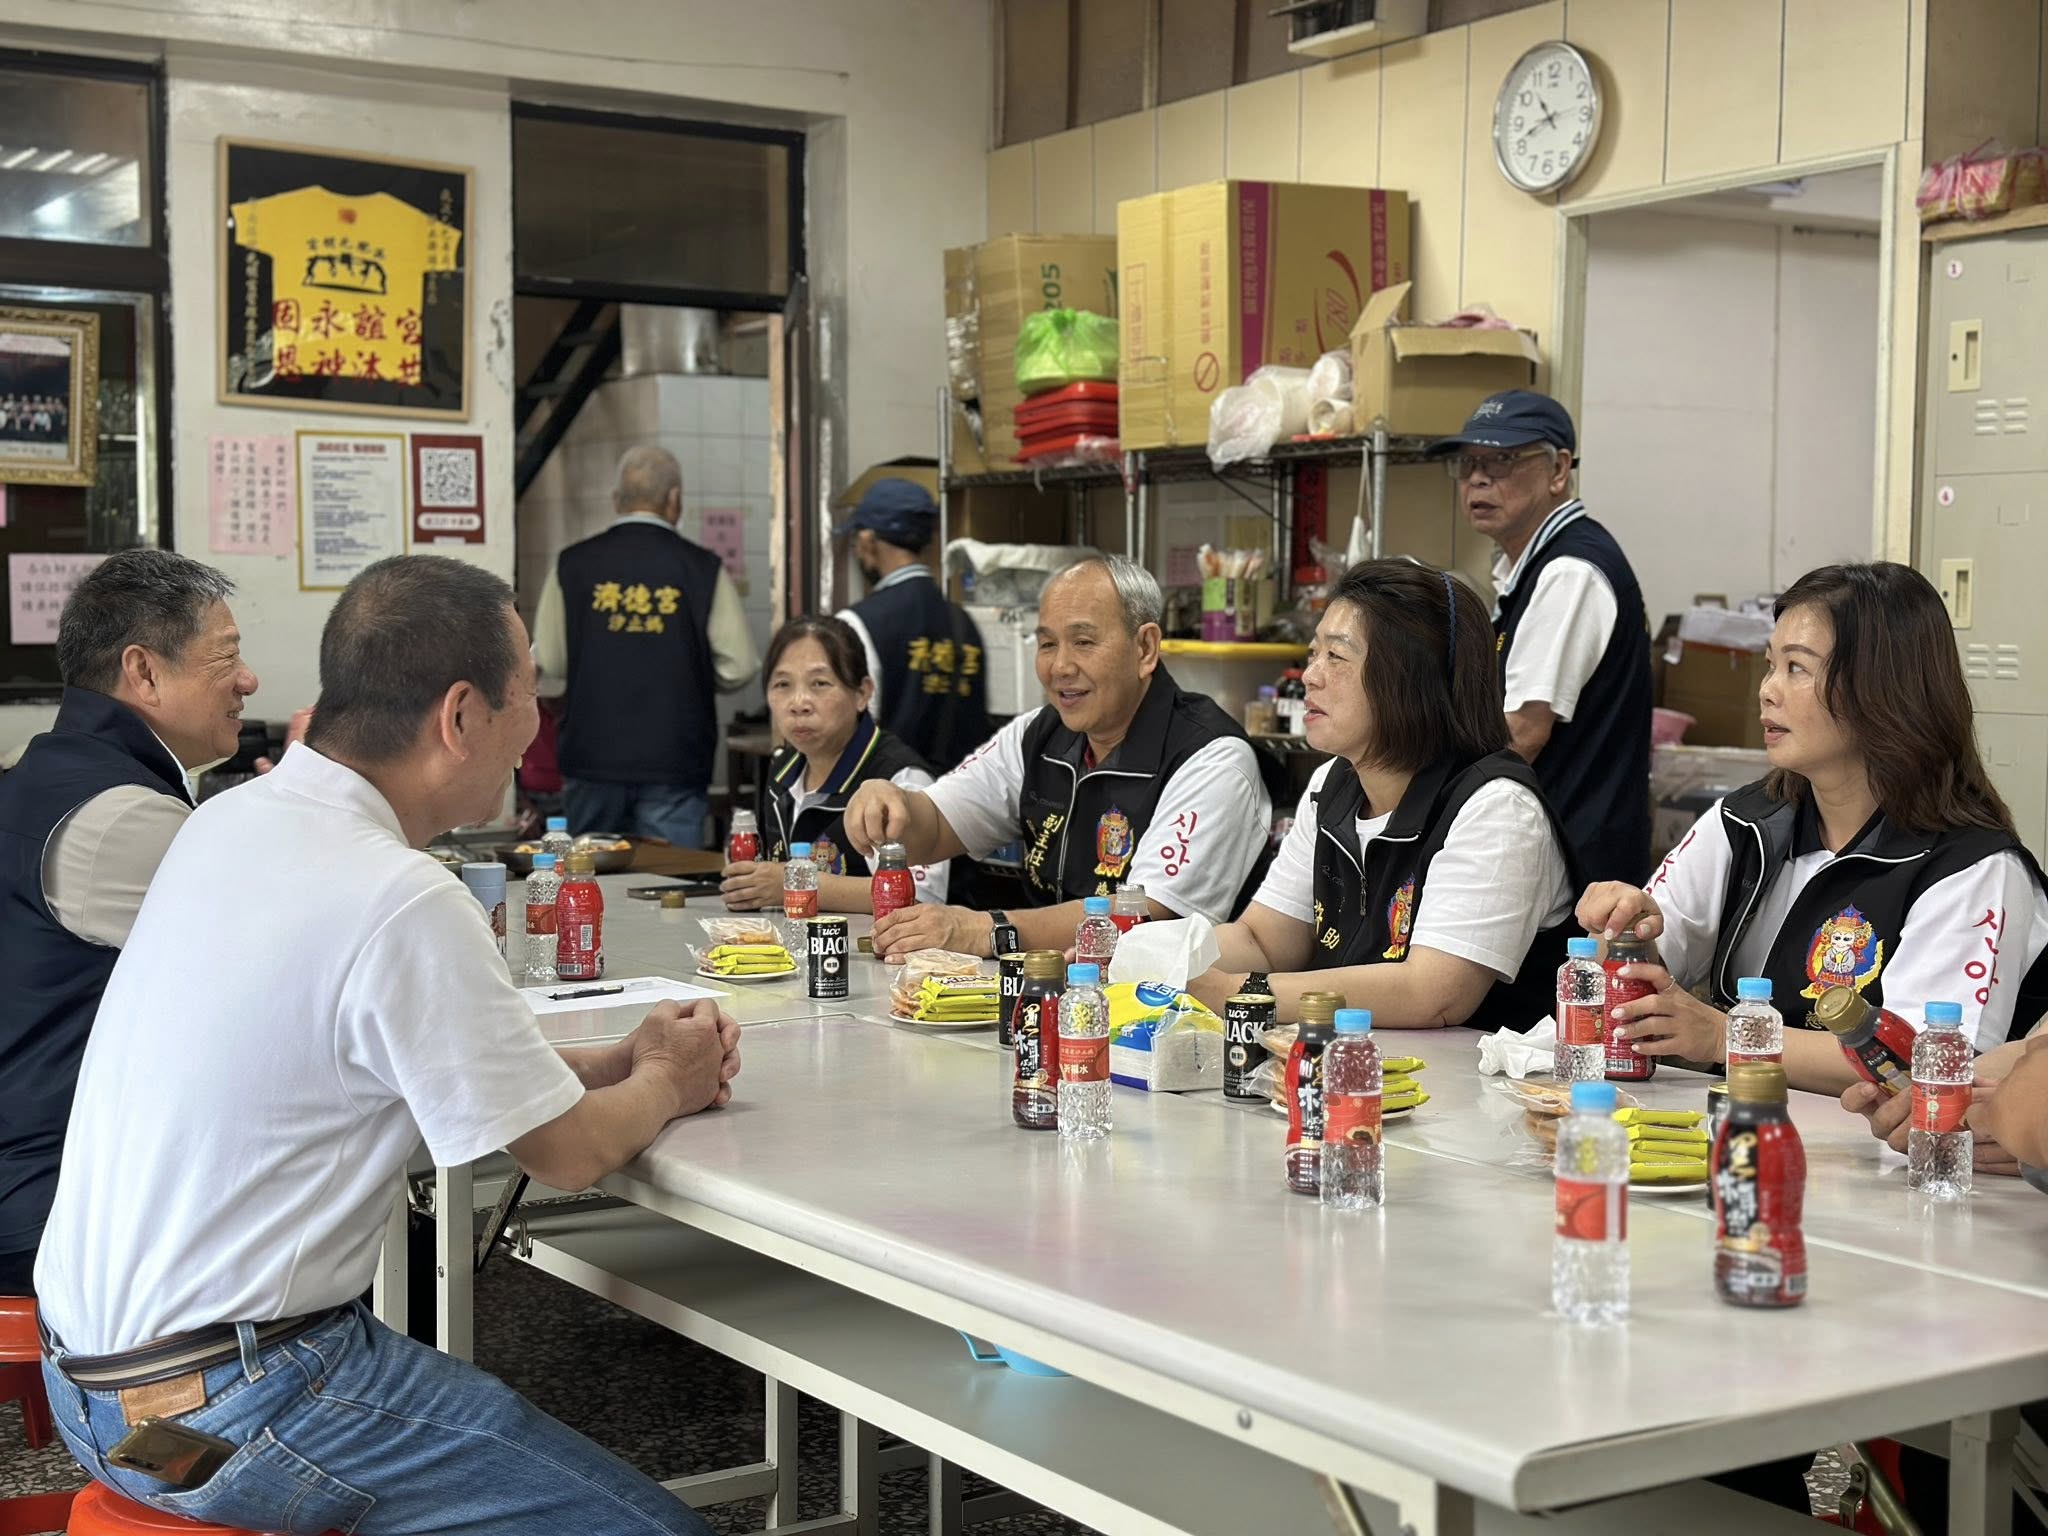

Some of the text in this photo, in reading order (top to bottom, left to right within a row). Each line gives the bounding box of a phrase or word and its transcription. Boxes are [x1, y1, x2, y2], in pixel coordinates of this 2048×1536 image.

[1548, 61, 1561, 79] 12
[1519, 90, 1533, 107] 10
[1577, 82, 1588, 99] 2
[1579, 106, 1592, 123] 3
[1514, 116, 1525, 132] 9
[1517, 139, 1528, 156] 8
[1529, 155, 1538, 172] 7
[1542, 159, 1553, 175] 6
[1558, 151, 1570, 167] 5
[1161, 811, 1198, 877] 신앙
[810, 935, 849, 956] BLACK
[1226, 1020, 1266, 1044] LACK
